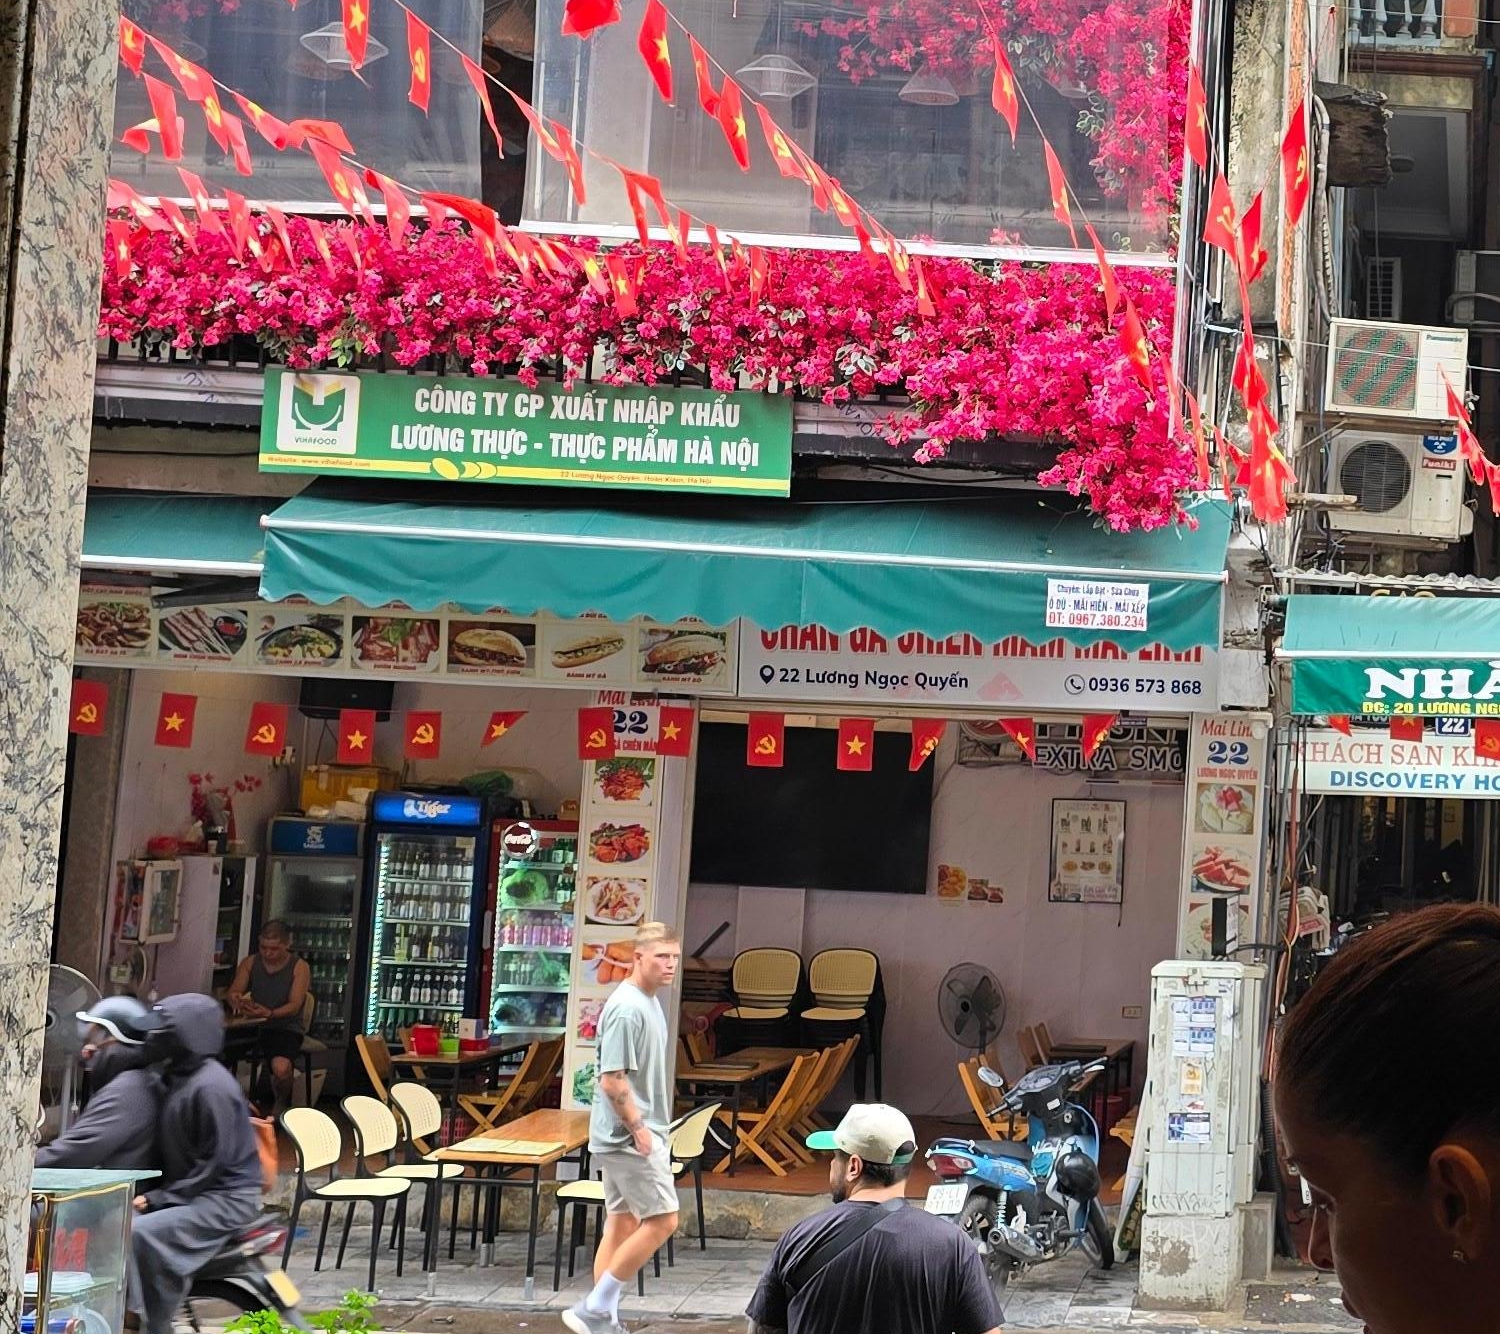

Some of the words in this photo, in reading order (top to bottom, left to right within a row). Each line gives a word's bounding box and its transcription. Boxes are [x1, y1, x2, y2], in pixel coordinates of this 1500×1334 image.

[415, 384, 476, 415] CÔNG
[483, 391, 508, 417] TY
[515, 393, 544, 418] CP
[550, 389, 608, 422] XUẤT
[613, 396, 674, 429] NHẬP
[681, 394, 740, 427] KHẨU
[391, 424, 464, 452] LƯƠNG
[471, 428, 527, 460] THỰC
[549, 432, 605, 464] THỰC
[612, 428, 677, 463] PHẨM
[684, 435, 714, 464] HÀ
[721, 437, 759, 471] NỘI
[1069, 613, 1145, 628] 0967.380.234
[779, 668, 800, 684] 22
[806, 668, 859, 688] Lương
[865, 670, 908, 691] Ngọc
[914, 671, 968, 691] Quyến
[1088, 677, 1130, 693] 0936
[1135, 678, 1165, 694] 573
[1171, 679, 1201, 695] 868
[1394, 703, 1414, 714] 20
[1418, 701, 1471, 715] LƯƠNG
[613, 710, 649, 735] 22
[1201, 719, 1227, 736] Mai
[1230, 720, 1254, 738] Lin
[1442, 717, 1465, 733] 22
[1207, 740, 1250, 765] 22
[1330, 770, 1468, 790] DISCOVERY
[416, 800, 451, 818] Tiger
